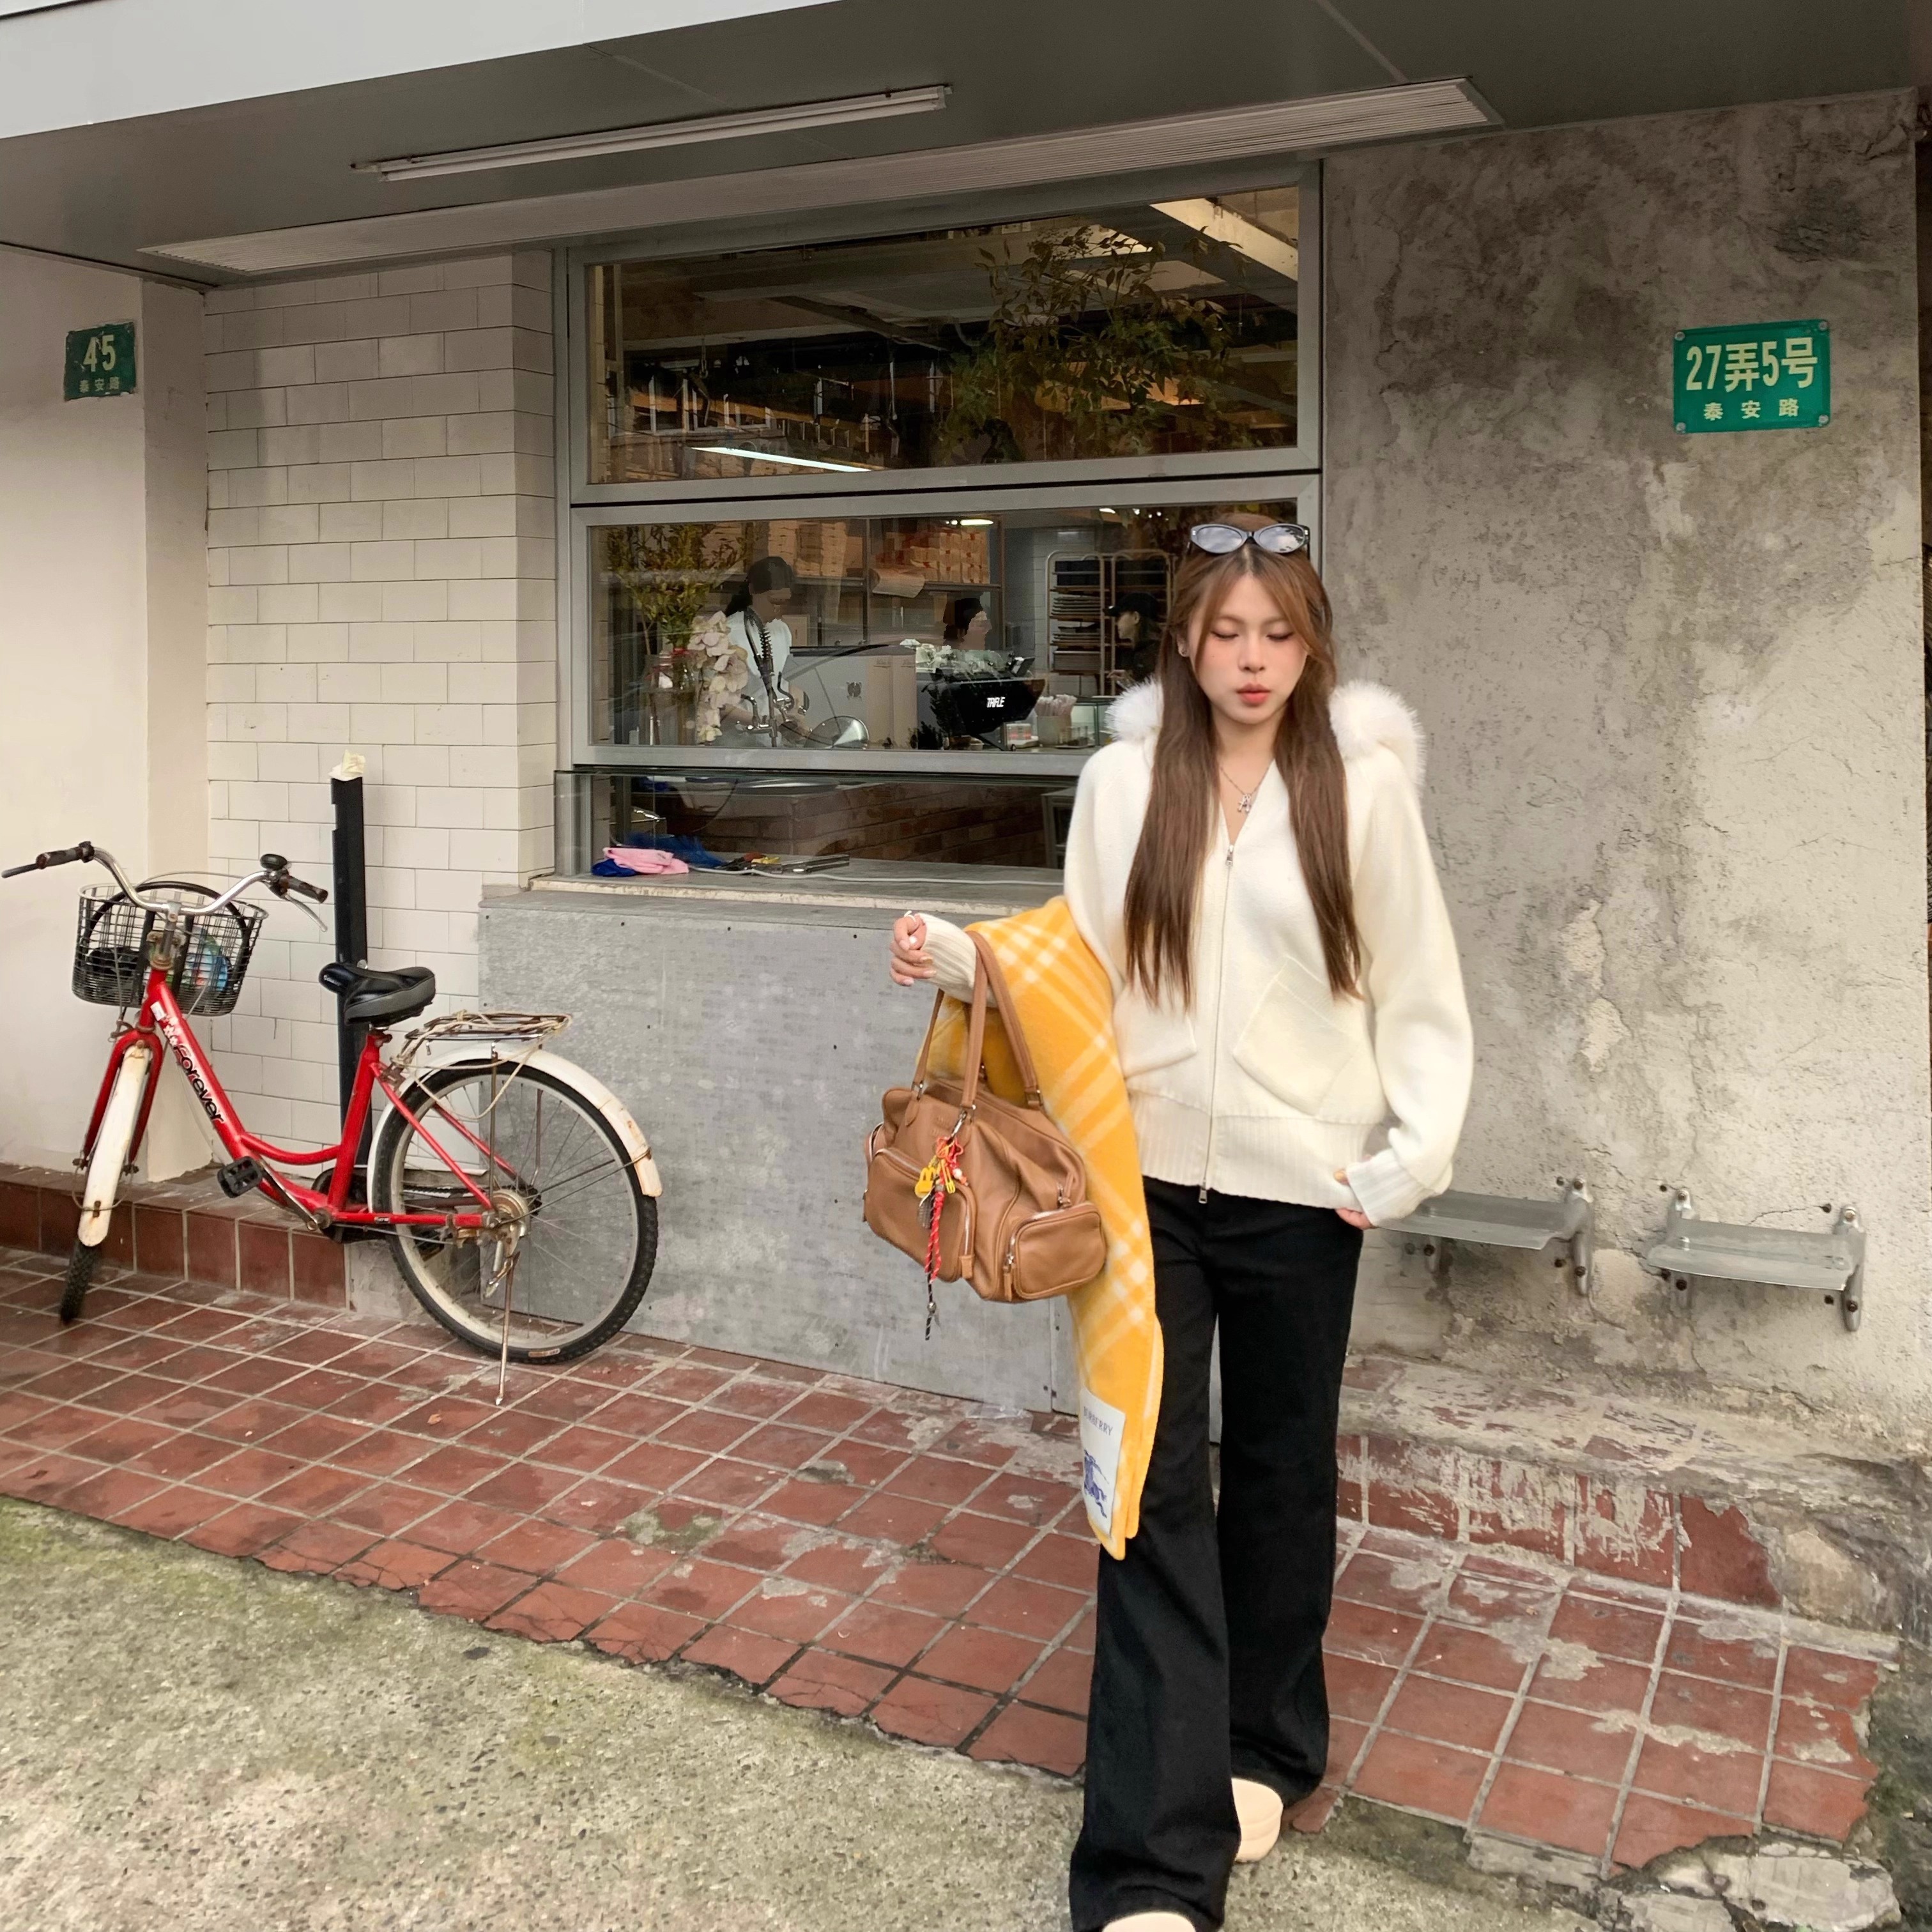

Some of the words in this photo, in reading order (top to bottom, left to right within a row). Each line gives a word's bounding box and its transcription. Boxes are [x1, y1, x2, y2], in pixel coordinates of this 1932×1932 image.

[83, 335, 116, 372] 45
[1686, 337, 1818, 392] 27弄5号
[173, 1045, 224, 1123] Forever
